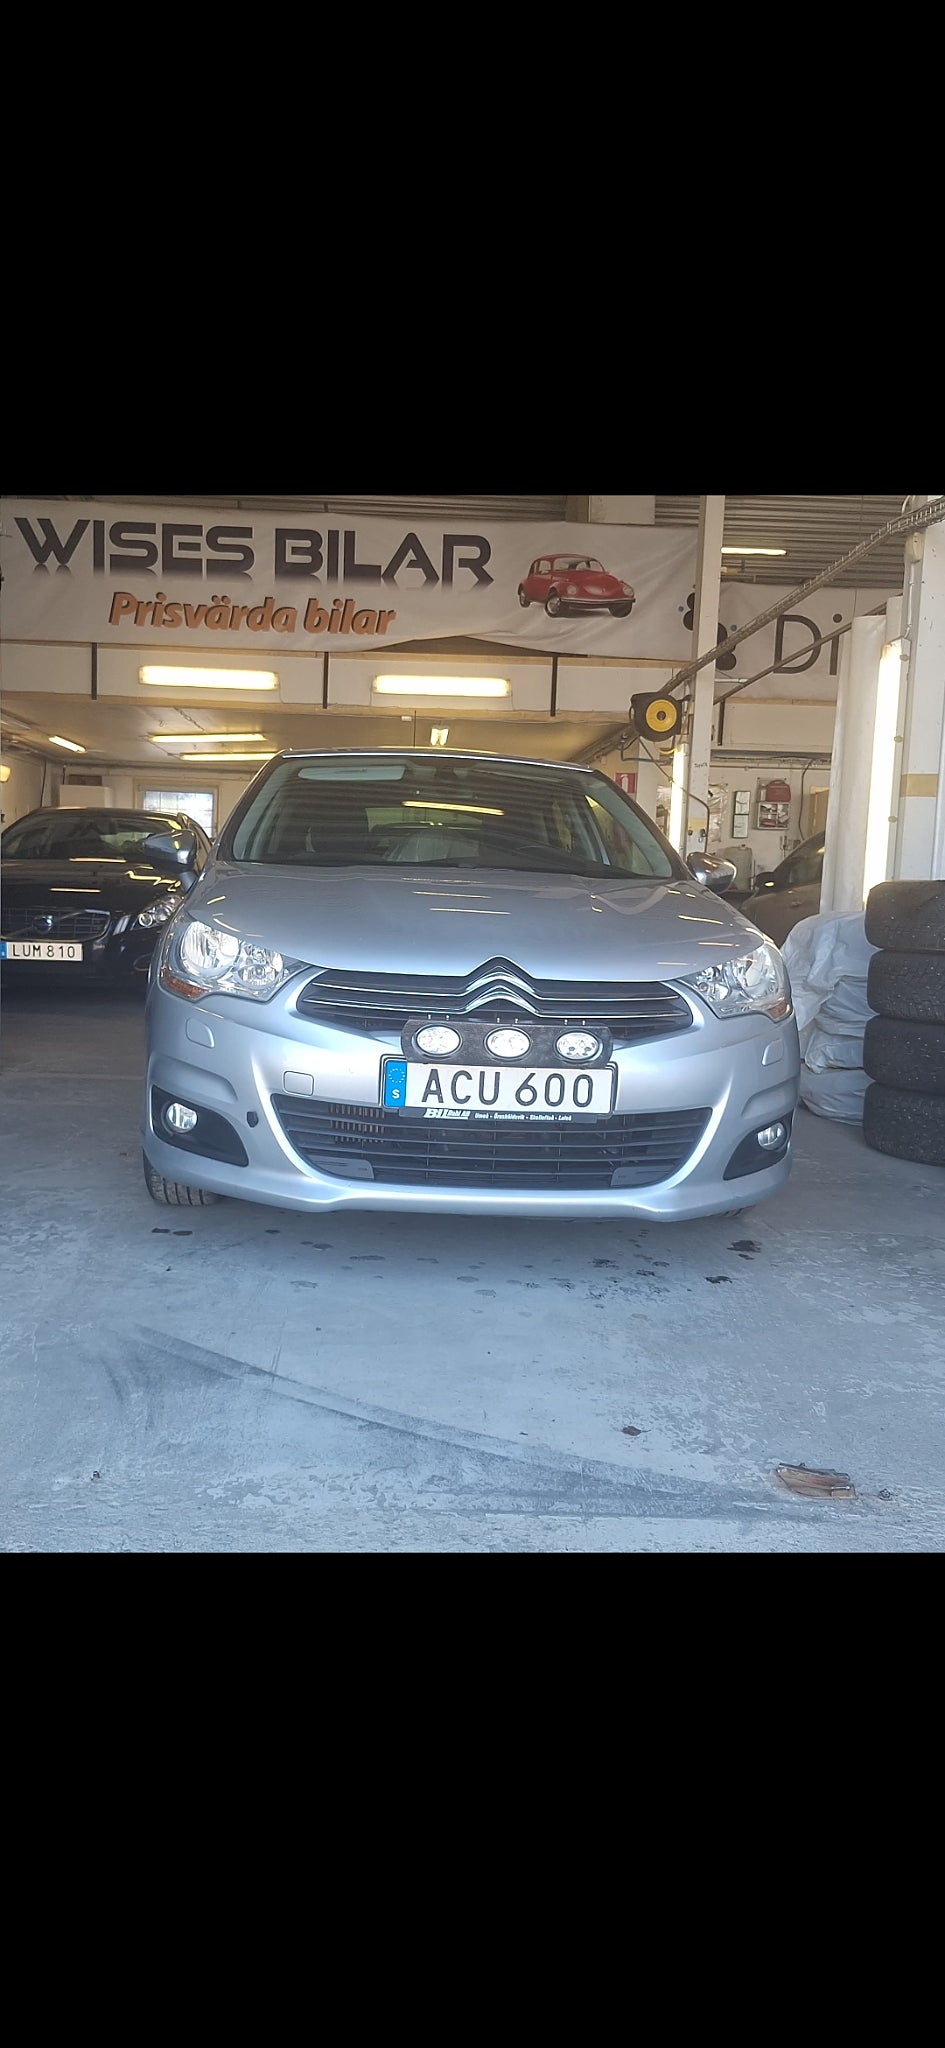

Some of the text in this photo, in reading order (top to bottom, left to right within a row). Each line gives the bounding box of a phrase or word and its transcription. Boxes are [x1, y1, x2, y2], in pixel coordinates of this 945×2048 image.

[14, 517, 494, 590] WISES BILAR
[108, 591, 397, 635] Prisvärda bilar
[12, 943, 76, 959] LUM 810
[391, 1088, 400, 1099] S
[421, 1068, 594, 1108] ACU 600
